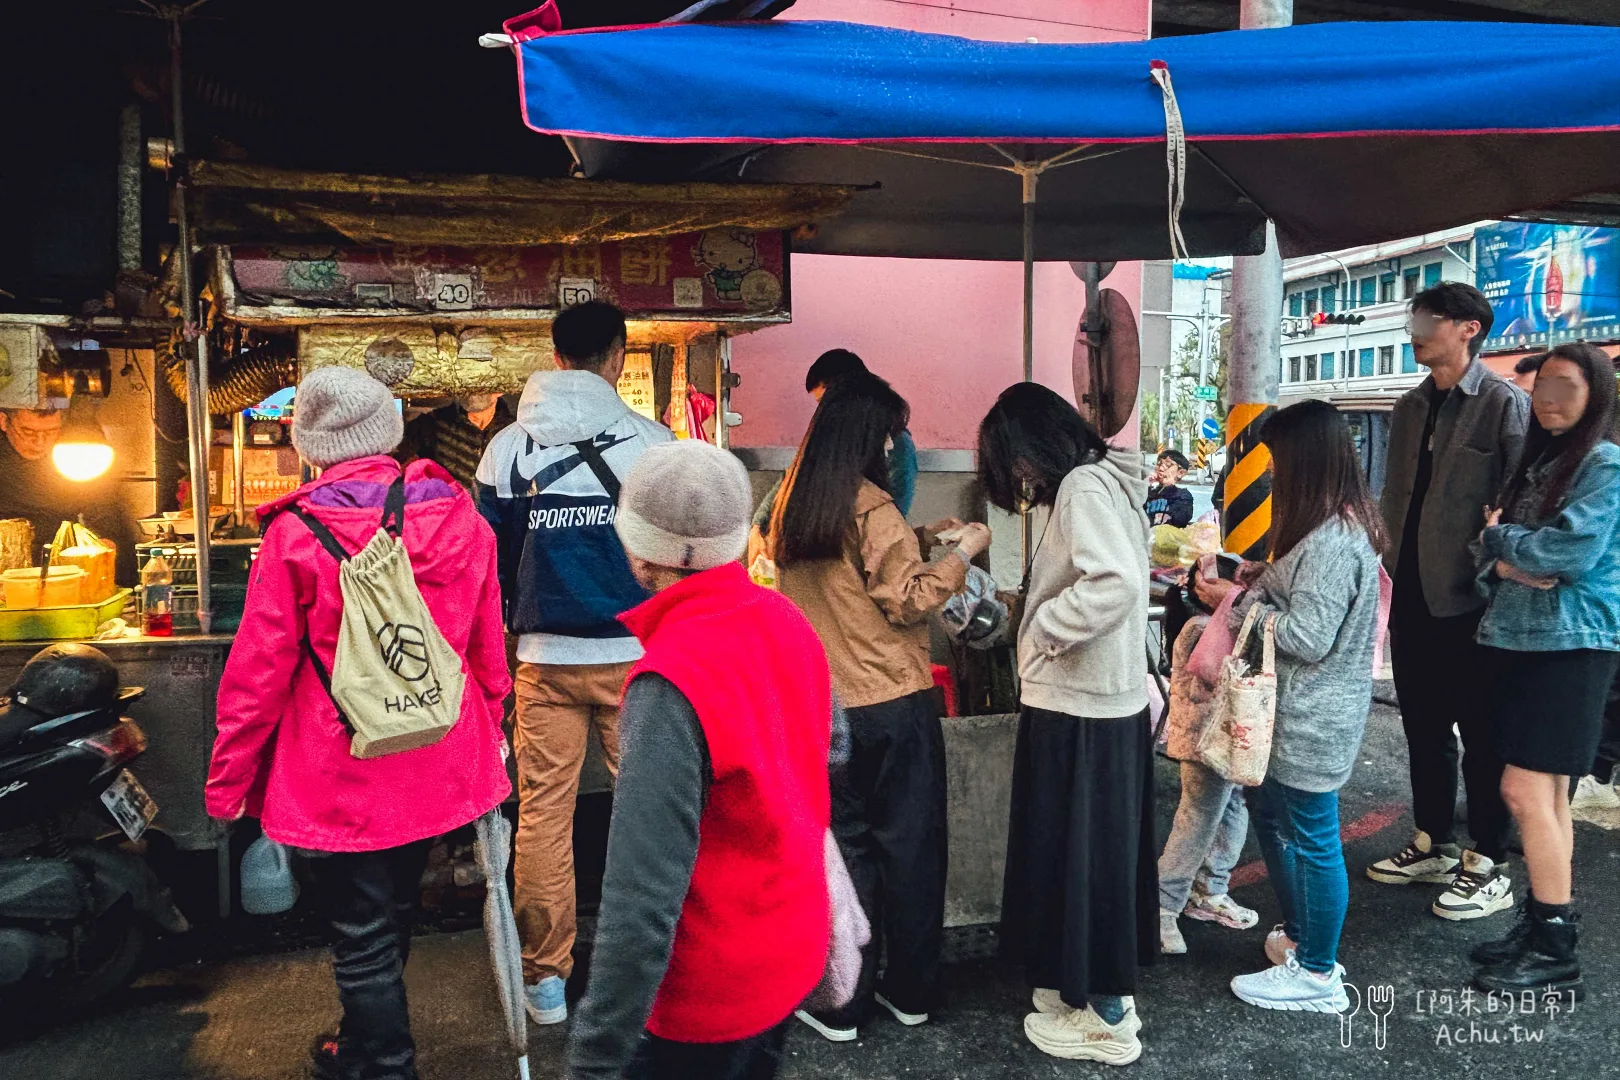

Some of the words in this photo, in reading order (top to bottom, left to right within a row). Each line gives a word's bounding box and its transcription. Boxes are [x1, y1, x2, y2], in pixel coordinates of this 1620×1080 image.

[438, 284, 470, 304] 40
[563, 287, 592, 306] 50
[633, 398, 643, 406] 50
[528, 505, 618, 530] SPORTSWEA
